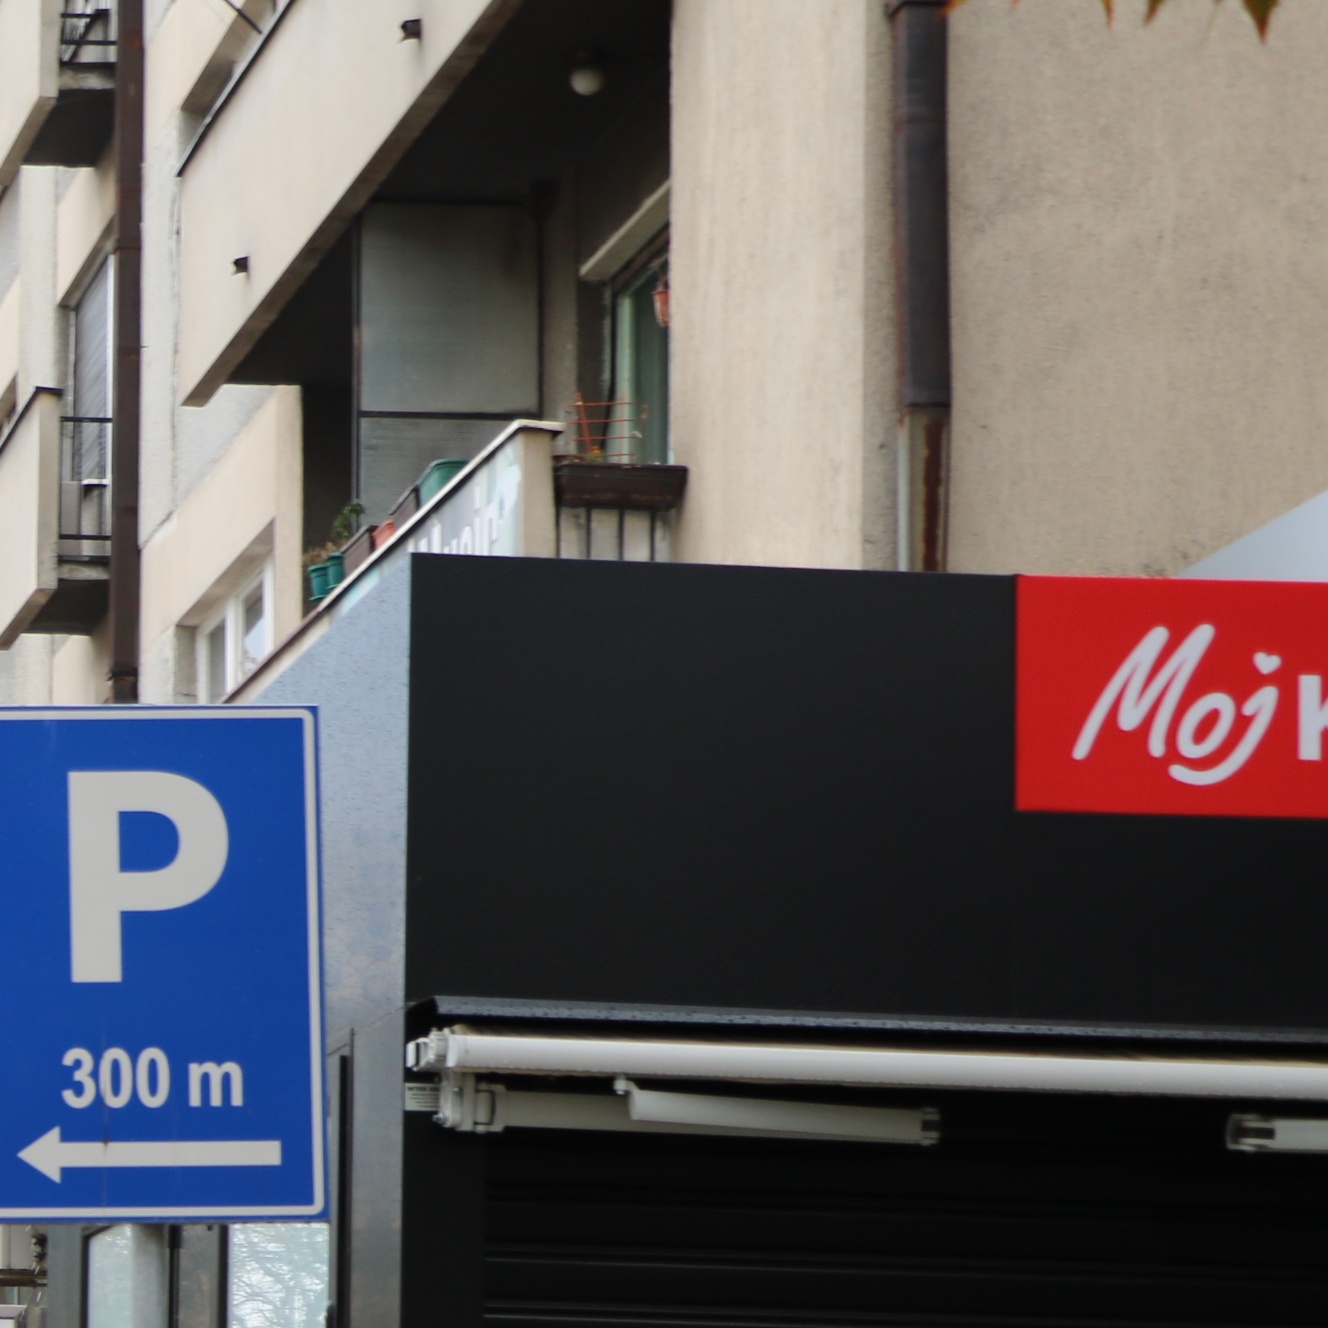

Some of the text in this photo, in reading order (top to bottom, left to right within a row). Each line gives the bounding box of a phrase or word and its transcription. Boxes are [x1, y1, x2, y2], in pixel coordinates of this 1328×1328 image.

[1071, 623, 1282, 785] Moj
[67, 770, 229, 982] P
[60, 1046, 244, 1109] 300 m
